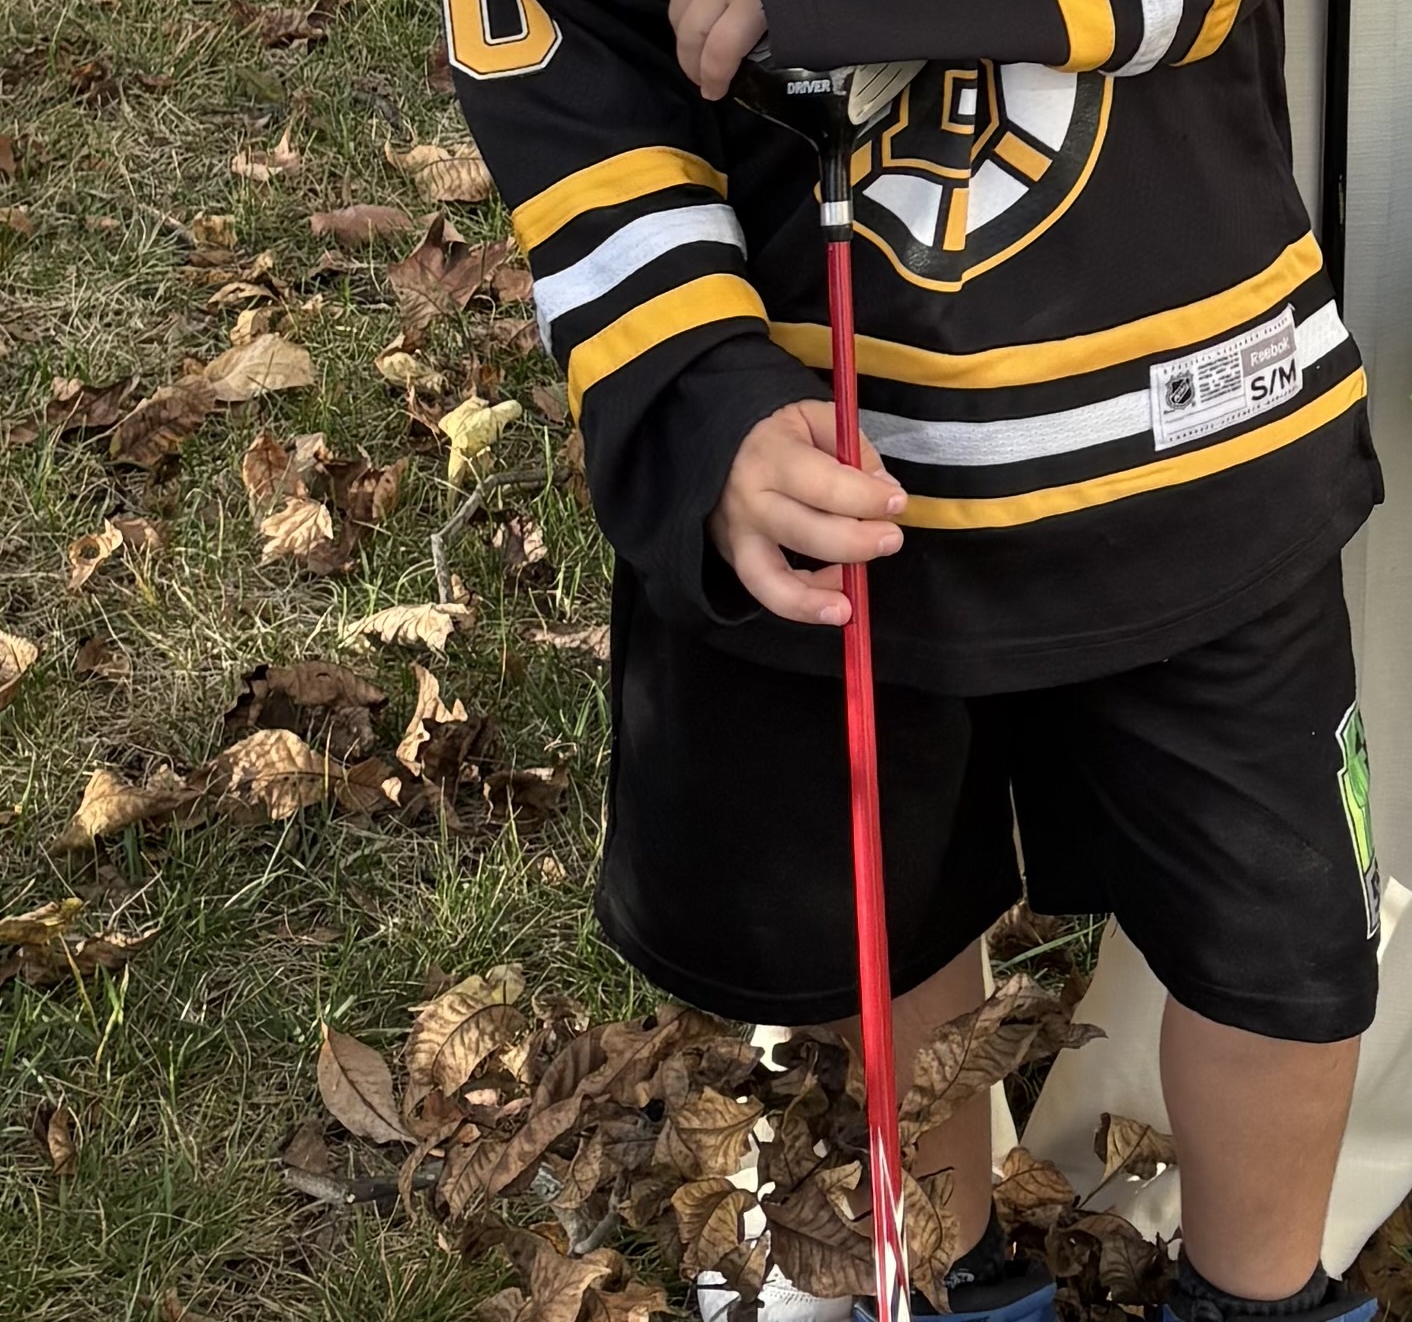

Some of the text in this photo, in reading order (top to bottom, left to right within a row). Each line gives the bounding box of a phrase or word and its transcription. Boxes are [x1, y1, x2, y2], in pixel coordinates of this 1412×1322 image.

[787, 79, 831, 95] DRIVER
[1250, 336, 1291, 367] Reebok
[1250, 358, 1297, 401] S/M
